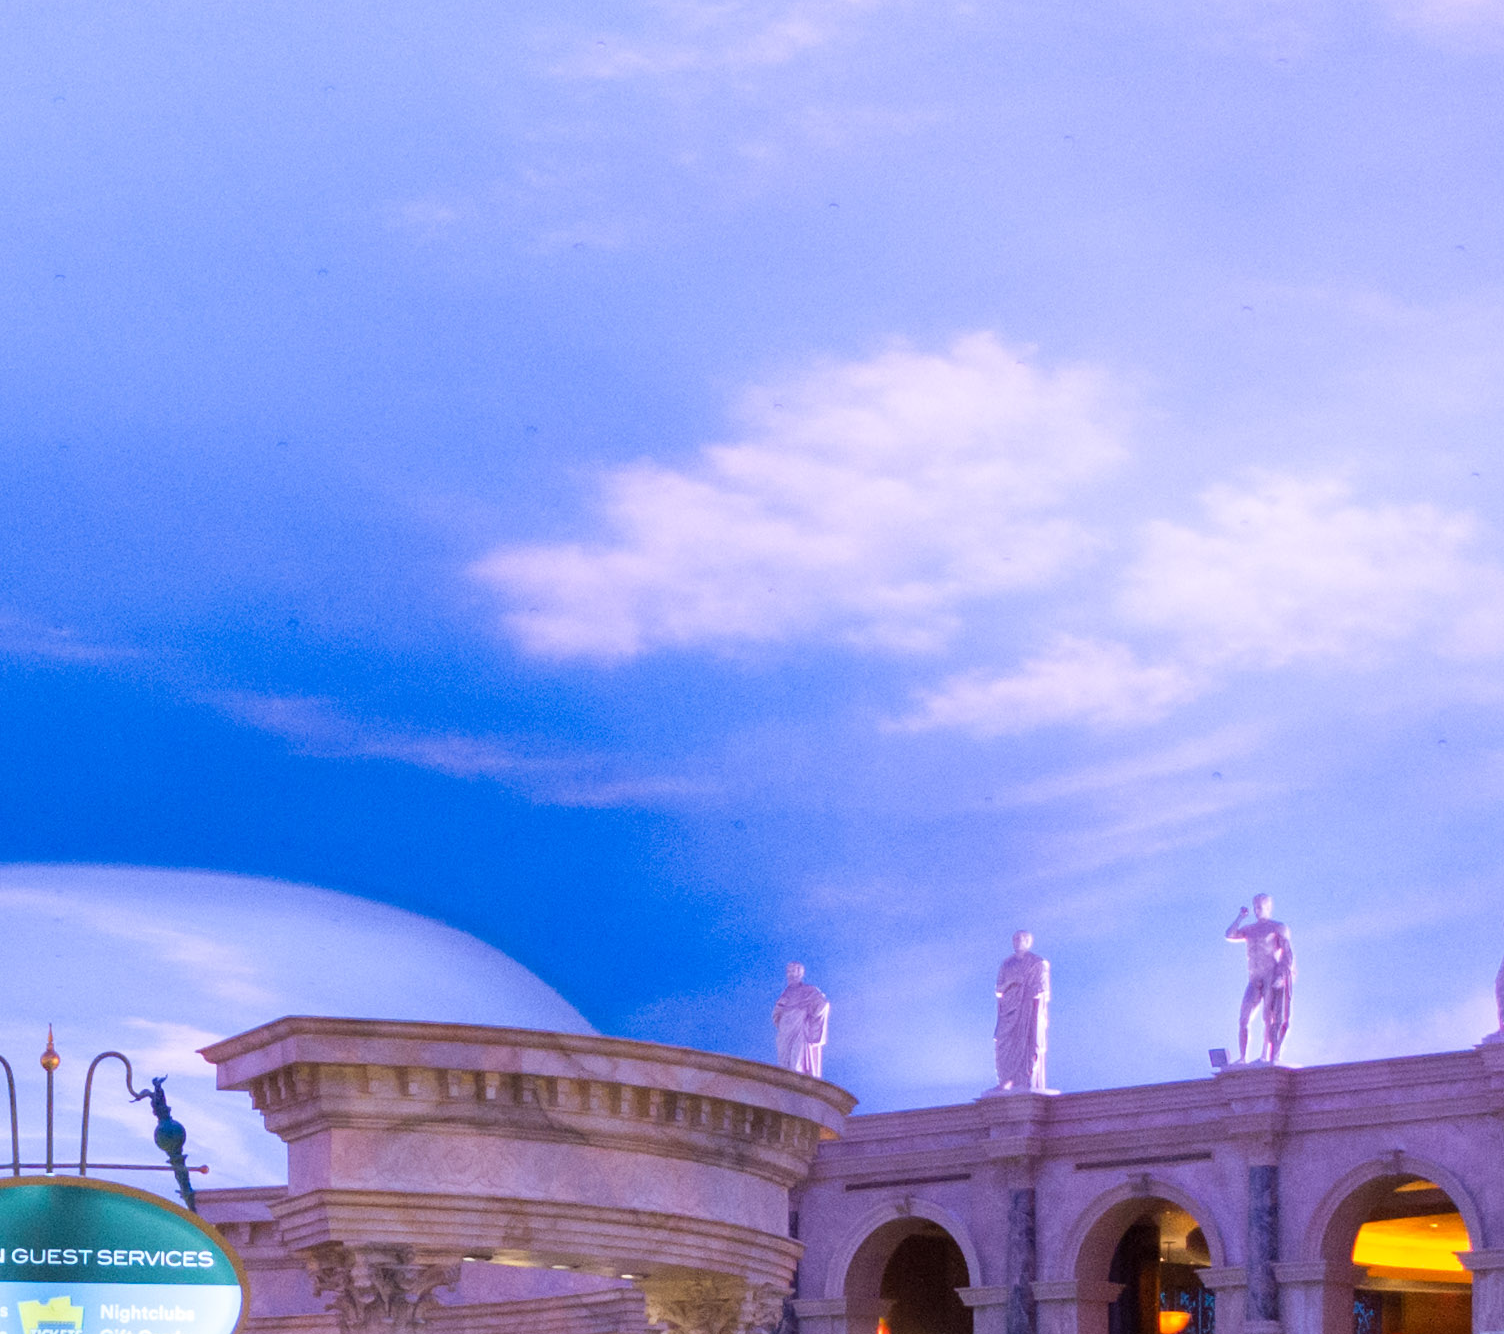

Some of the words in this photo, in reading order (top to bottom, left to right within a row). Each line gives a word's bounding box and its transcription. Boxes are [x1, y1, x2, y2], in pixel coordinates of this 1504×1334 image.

[11, 1248, 93, 1265] GUEST
[97, 1249, 215, 1267] SERVICES
[100, 1305, 195, 1323] Nightclubs
